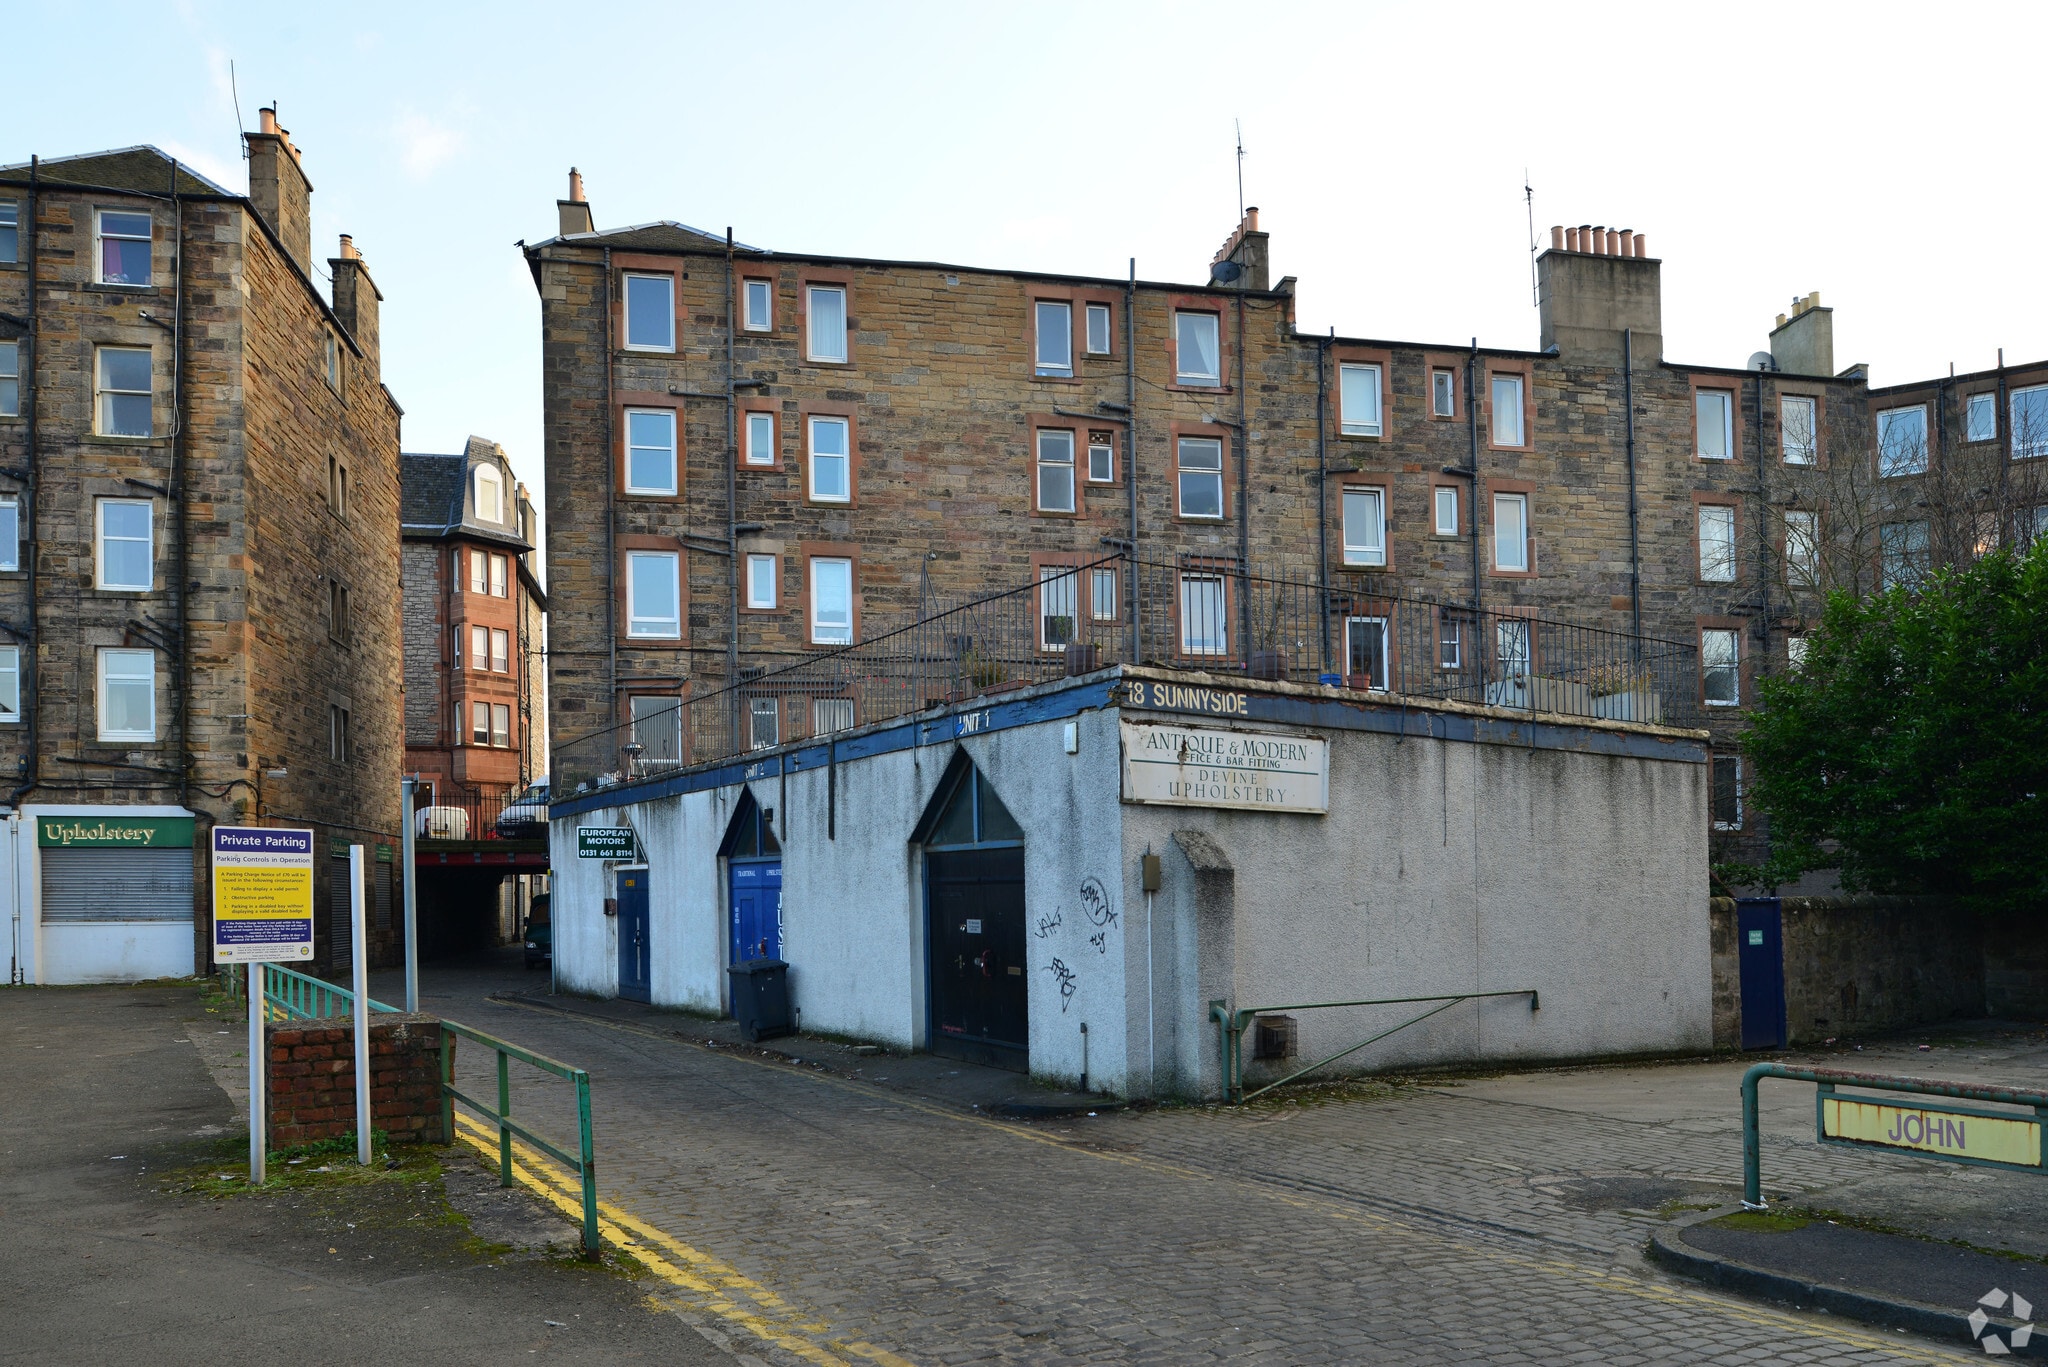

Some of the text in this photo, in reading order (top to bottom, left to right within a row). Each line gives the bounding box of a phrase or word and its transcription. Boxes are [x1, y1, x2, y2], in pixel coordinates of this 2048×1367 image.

[1127, 681, 1248, 714] 18 SUNNYSIDE
[985, 710, 989, 727] 1
[1230, 742, 1239, 755] &
[1242, 740, 1307, 761] MODERN
[1227, 756, 1243, 766] BAR
[1249, 758, 1280, 768] FITTING
[1200, 770, 1257, 785] DEVINE
[1169, 782, 1286, 802] UPHOLSTERY
[45, 822, 156, 844] Upholstery
[221, 835, 306, 849] Private Parking
[1888, 1114, 1965, 1149] JOHN
